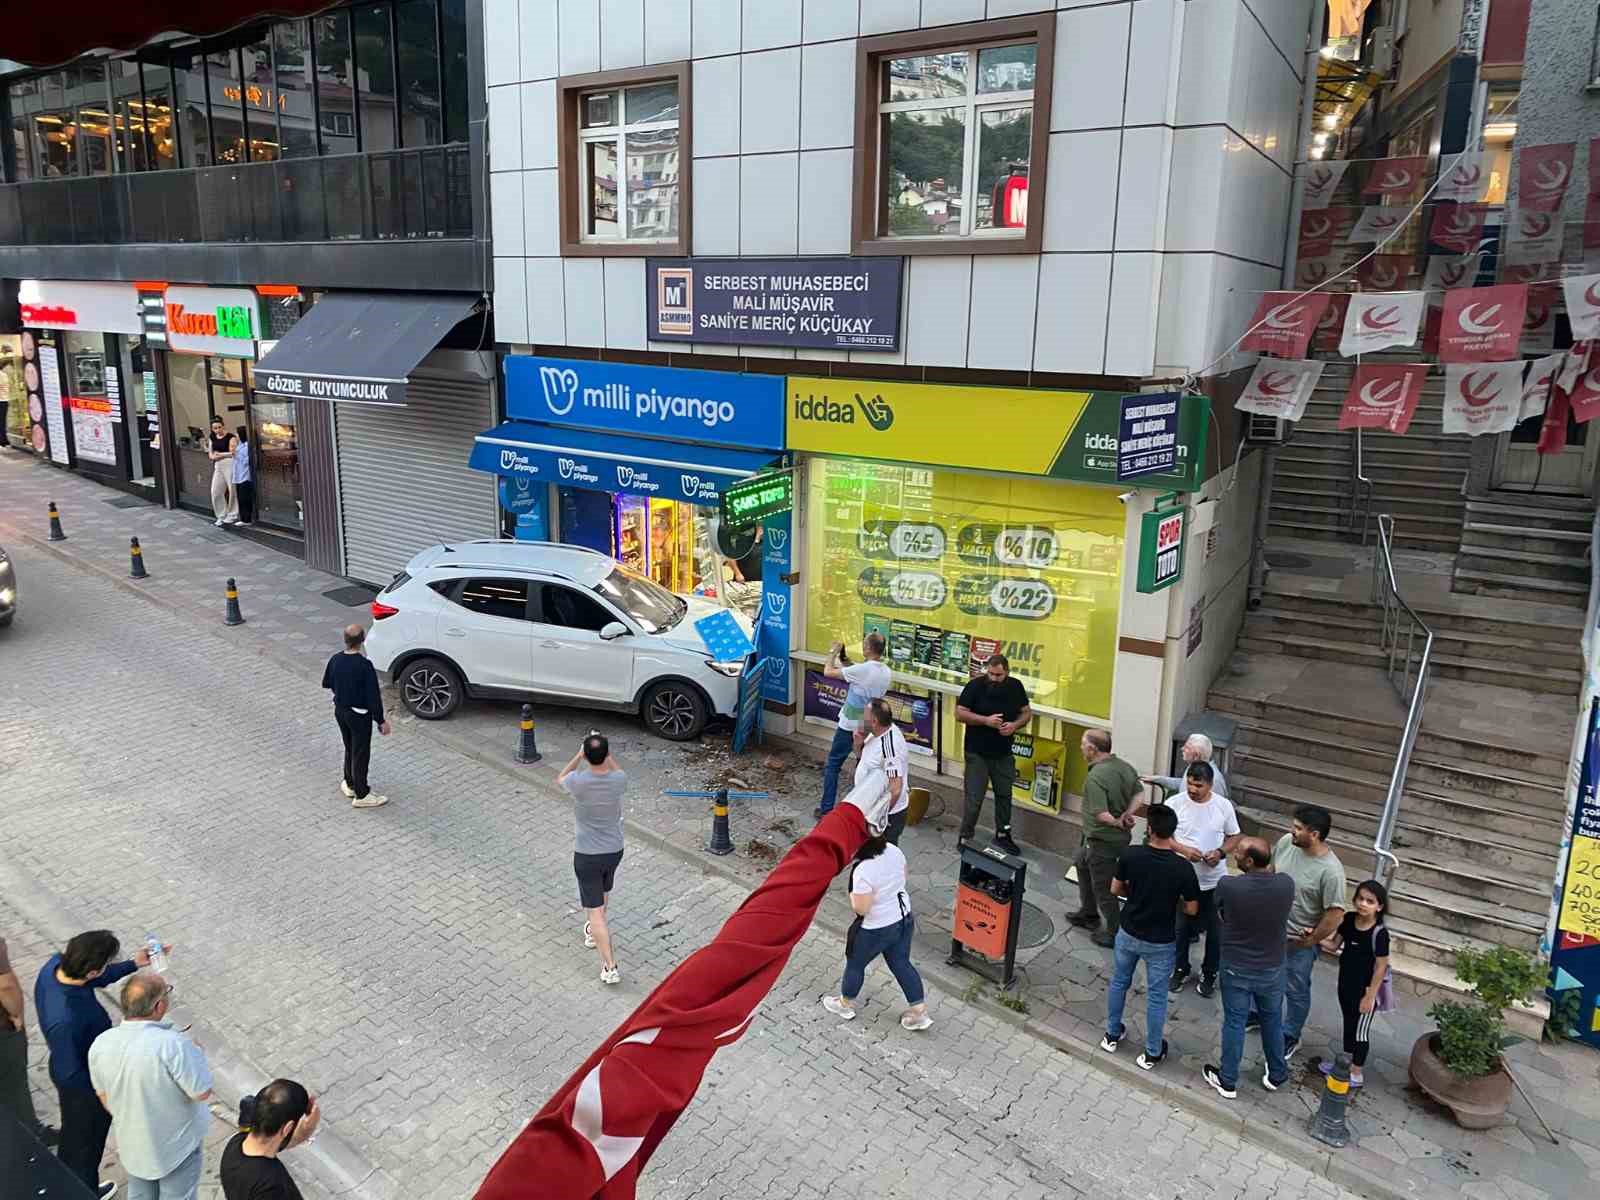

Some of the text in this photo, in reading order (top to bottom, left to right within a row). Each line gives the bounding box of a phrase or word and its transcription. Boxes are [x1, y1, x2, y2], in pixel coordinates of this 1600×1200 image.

[704, 273, 869, 291] SERBEST MUHASEBECİ
[733, 293, 834, 314] MALİ MÜŞAVİR
[700, 312, 873, 335] SANİYE MERİÇ KÜÇÜKAY
[267, 375, 388, 400] GÖZDE KUYUMCULUK
[584, 384, 735, 426] milli piyango
[794, 393, 855, 424] iddaa
[514, 463, 539, 474] piyango
[515, 456, 529, 464] milli
[573, 464, 588, 473] milli
[573, 473, 599, 483] piyango
[632, 481, 659, 492] piyango
[633, 472, 648, 481] milli
[699, 489, 719, 500] piyan
[904, 531, 934, 552] %5
[1159, 518, 1180, 548] SPOR
[1005, 536, 1051, 559] %10
[1157, 549, 1177, 580] TOTO
[1001, 586, 1048, 610] %22
